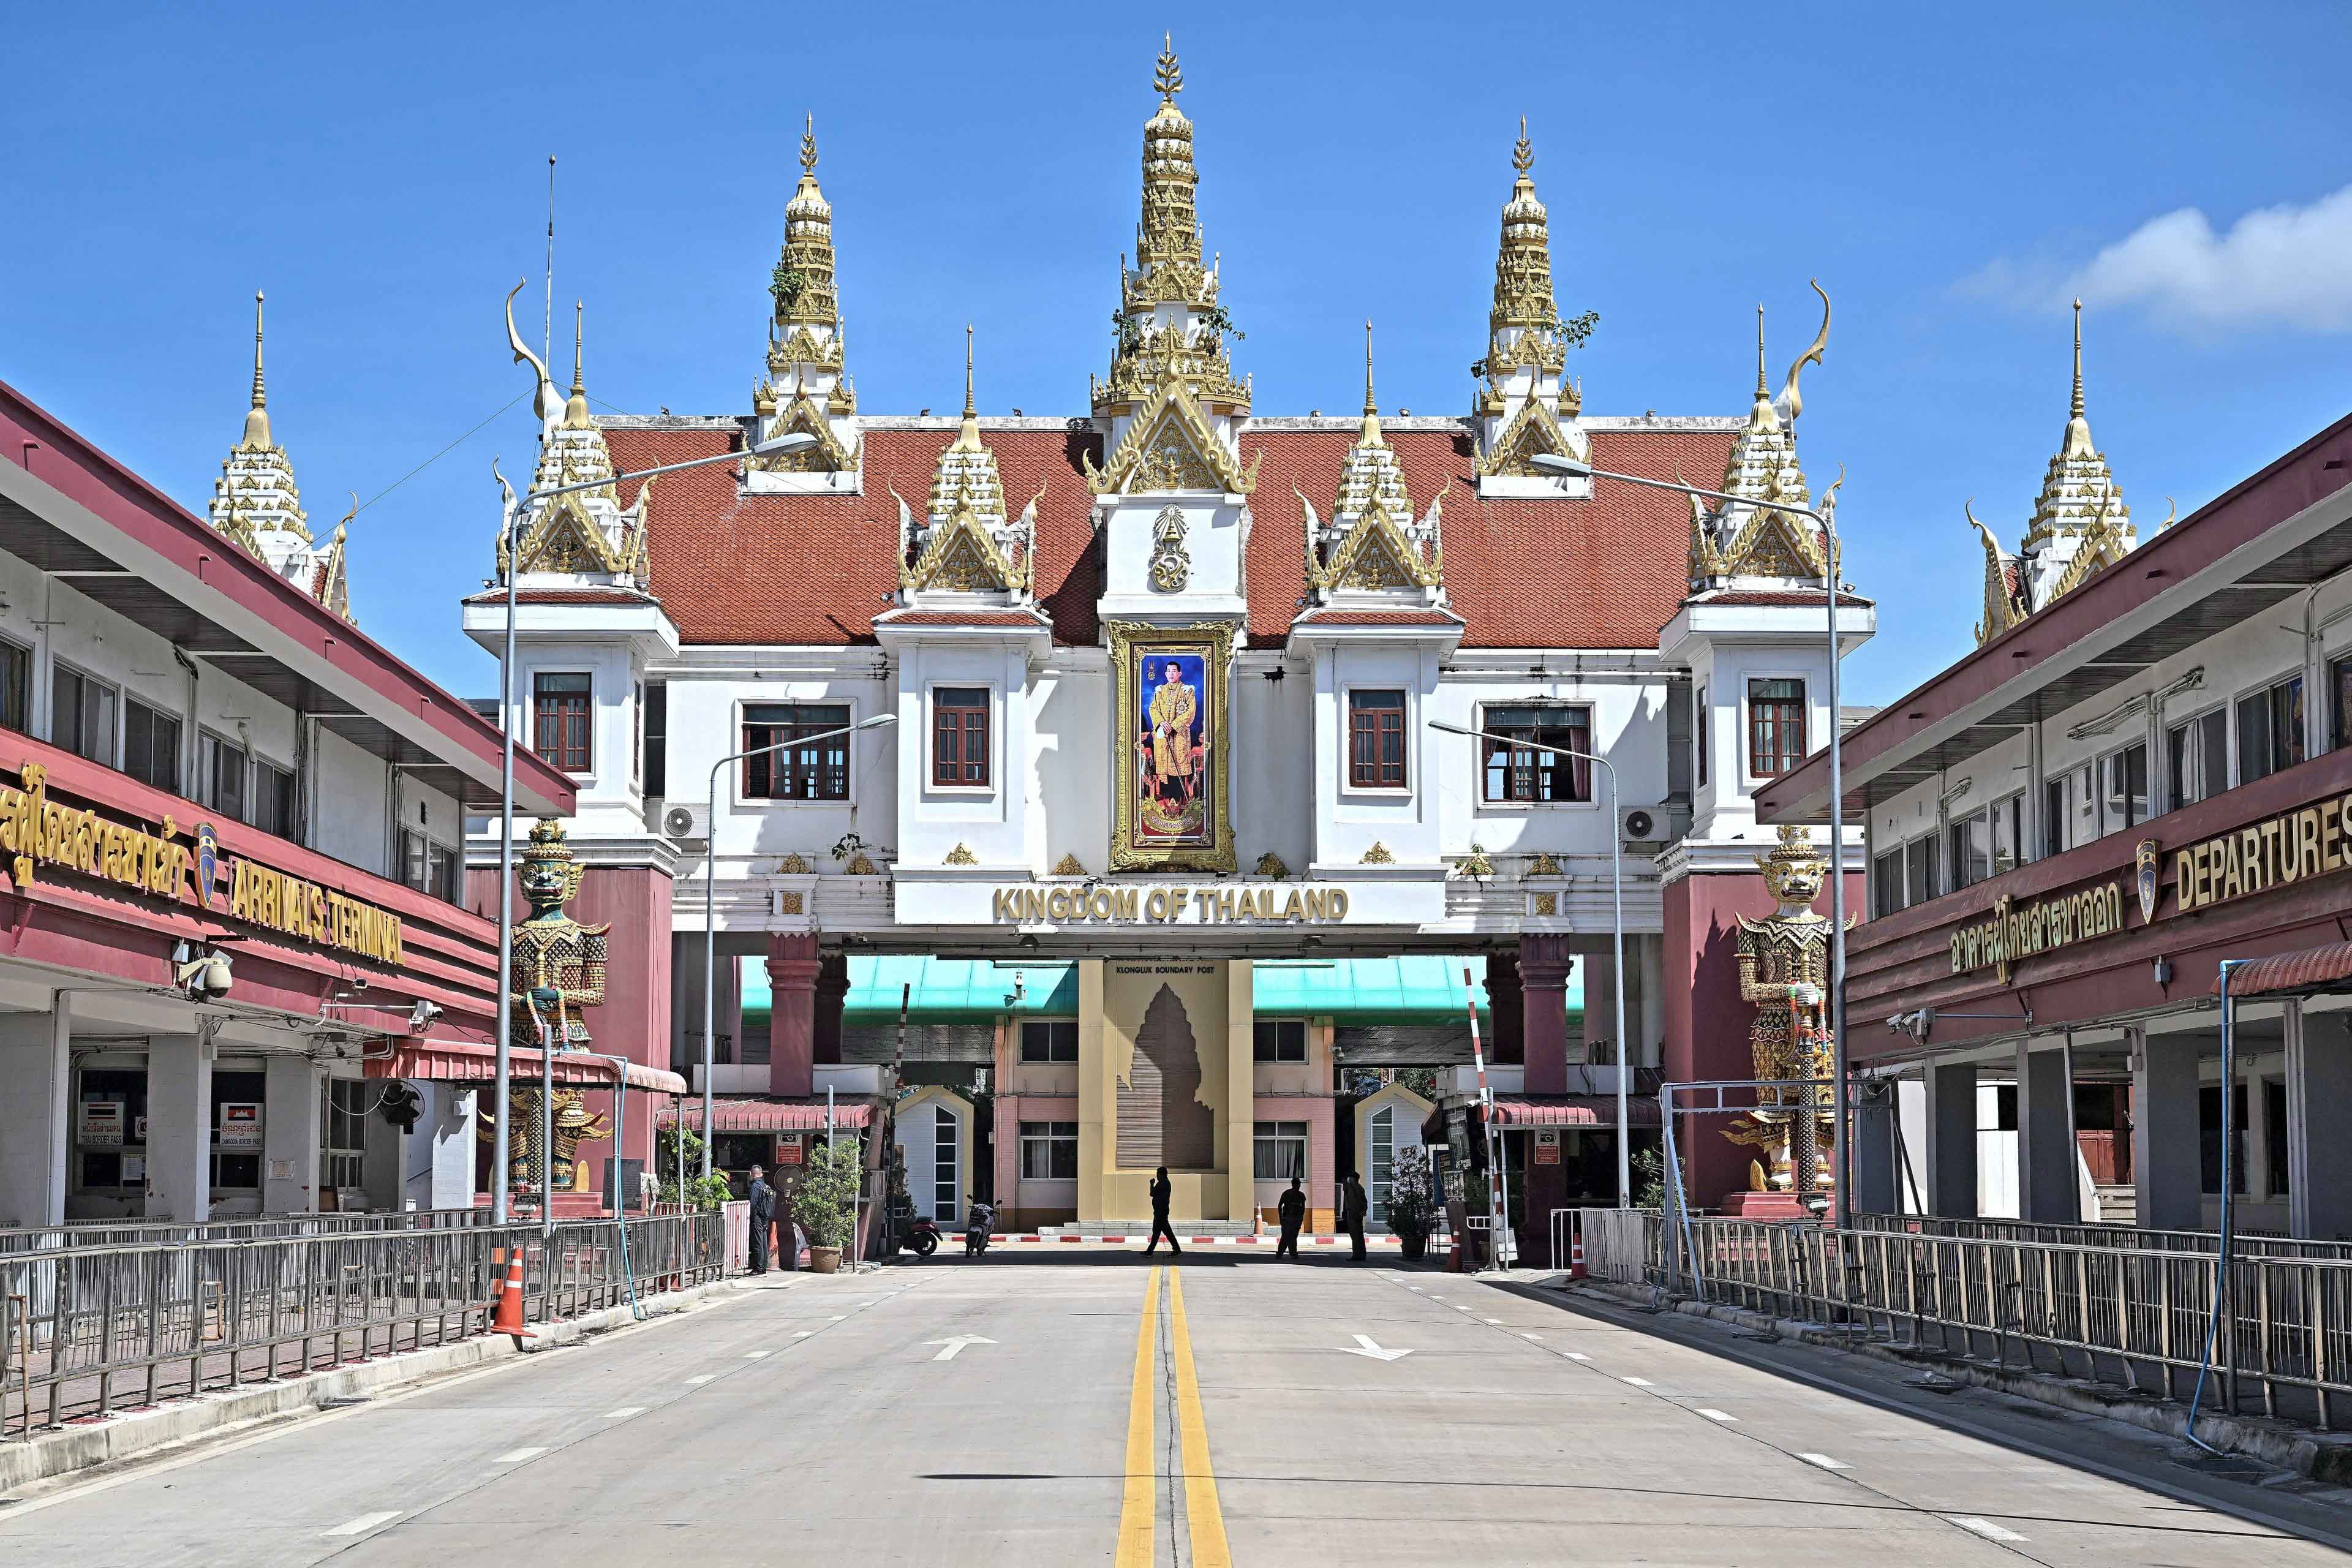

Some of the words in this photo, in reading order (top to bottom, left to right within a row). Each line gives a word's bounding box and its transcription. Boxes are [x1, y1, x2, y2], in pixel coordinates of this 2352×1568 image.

[232, 859, 324, 940] ARRIVALS
[328, 891, 405, 966] TERMINAL
[995, 888, 1138, 919] KINGDOM
[1147, 888, 1188, 919] OF
[1196, 888, 1349, 919] THAILAND
[1950, 882, 2123, 984] อาคารผู้โดยสารขาออก
[81, 1136, 91, 1144] THAI
[92, 1136, 110, 1144] BORDER
[111, 1136, 122, 1144] PASS
